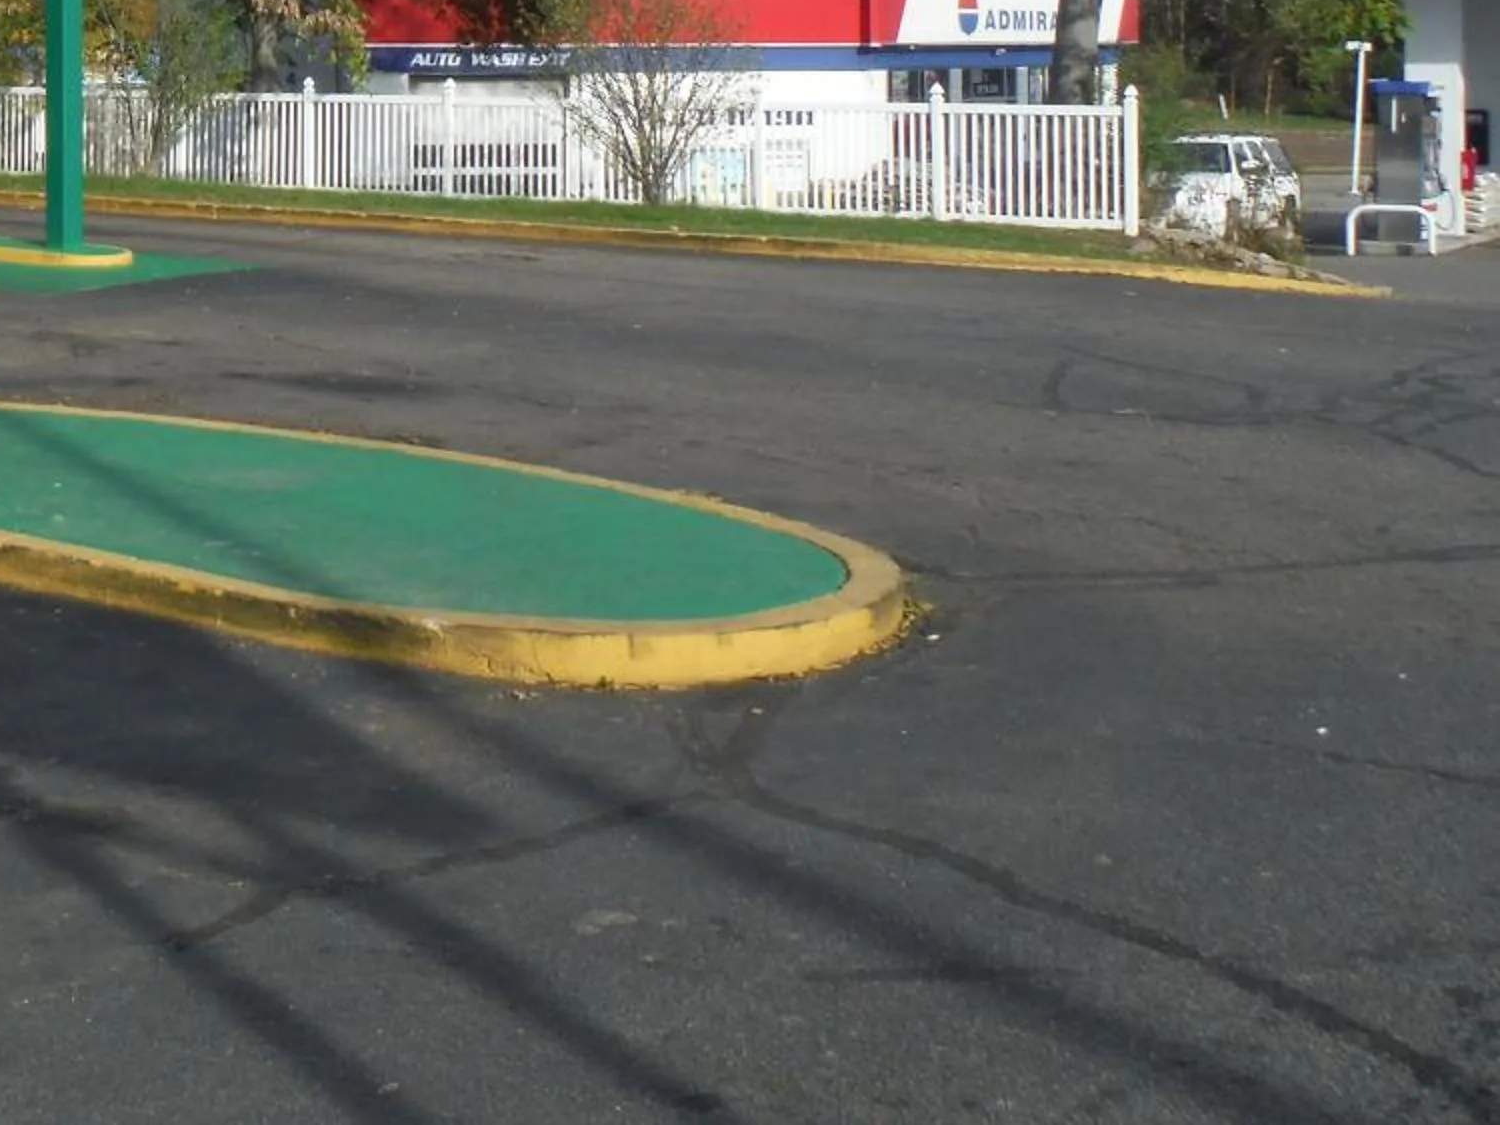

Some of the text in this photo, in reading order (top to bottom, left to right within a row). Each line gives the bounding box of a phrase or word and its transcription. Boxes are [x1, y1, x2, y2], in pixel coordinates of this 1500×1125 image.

[984, 9, 1059, 31] ADMIRA
[410, 52, 462, 67] AUTO
[470, 53, 525, 67] WASH
